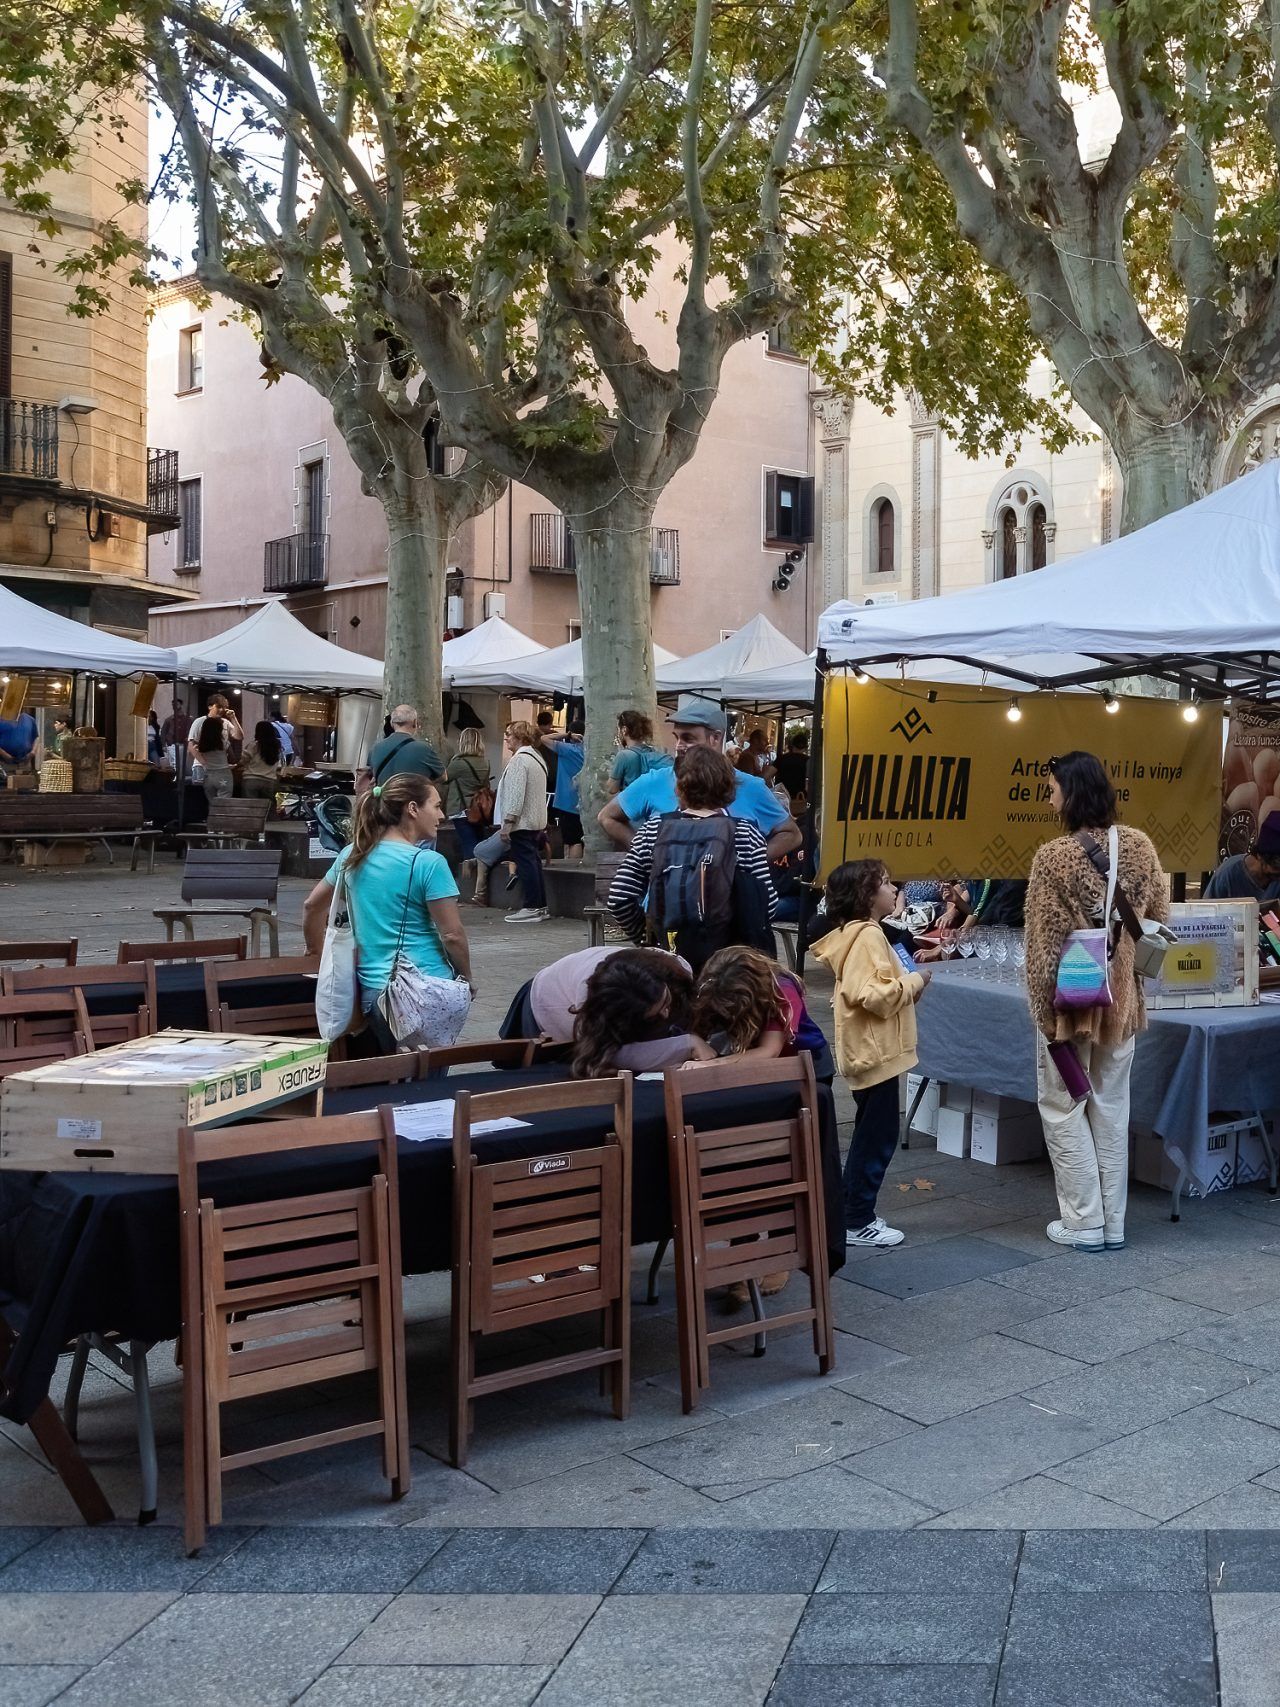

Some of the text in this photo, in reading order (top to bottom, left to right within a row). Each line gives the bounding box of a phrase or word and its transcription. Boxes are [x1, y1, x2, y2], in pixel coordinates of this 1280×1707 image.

[1110, 760, 1121, 778] vi
[1124, 760, 1129, 778] i
[1132, 760, 1145, 779] la
[1149, 762, 1183, 784] vinya
[836, 754, 972, 822] VALLALTA
[1008, 782, 1031, 801] de
[858, 829, 934, 848] VINÍCOLA
[278, 1063, 322, 1093] FRUDEX
